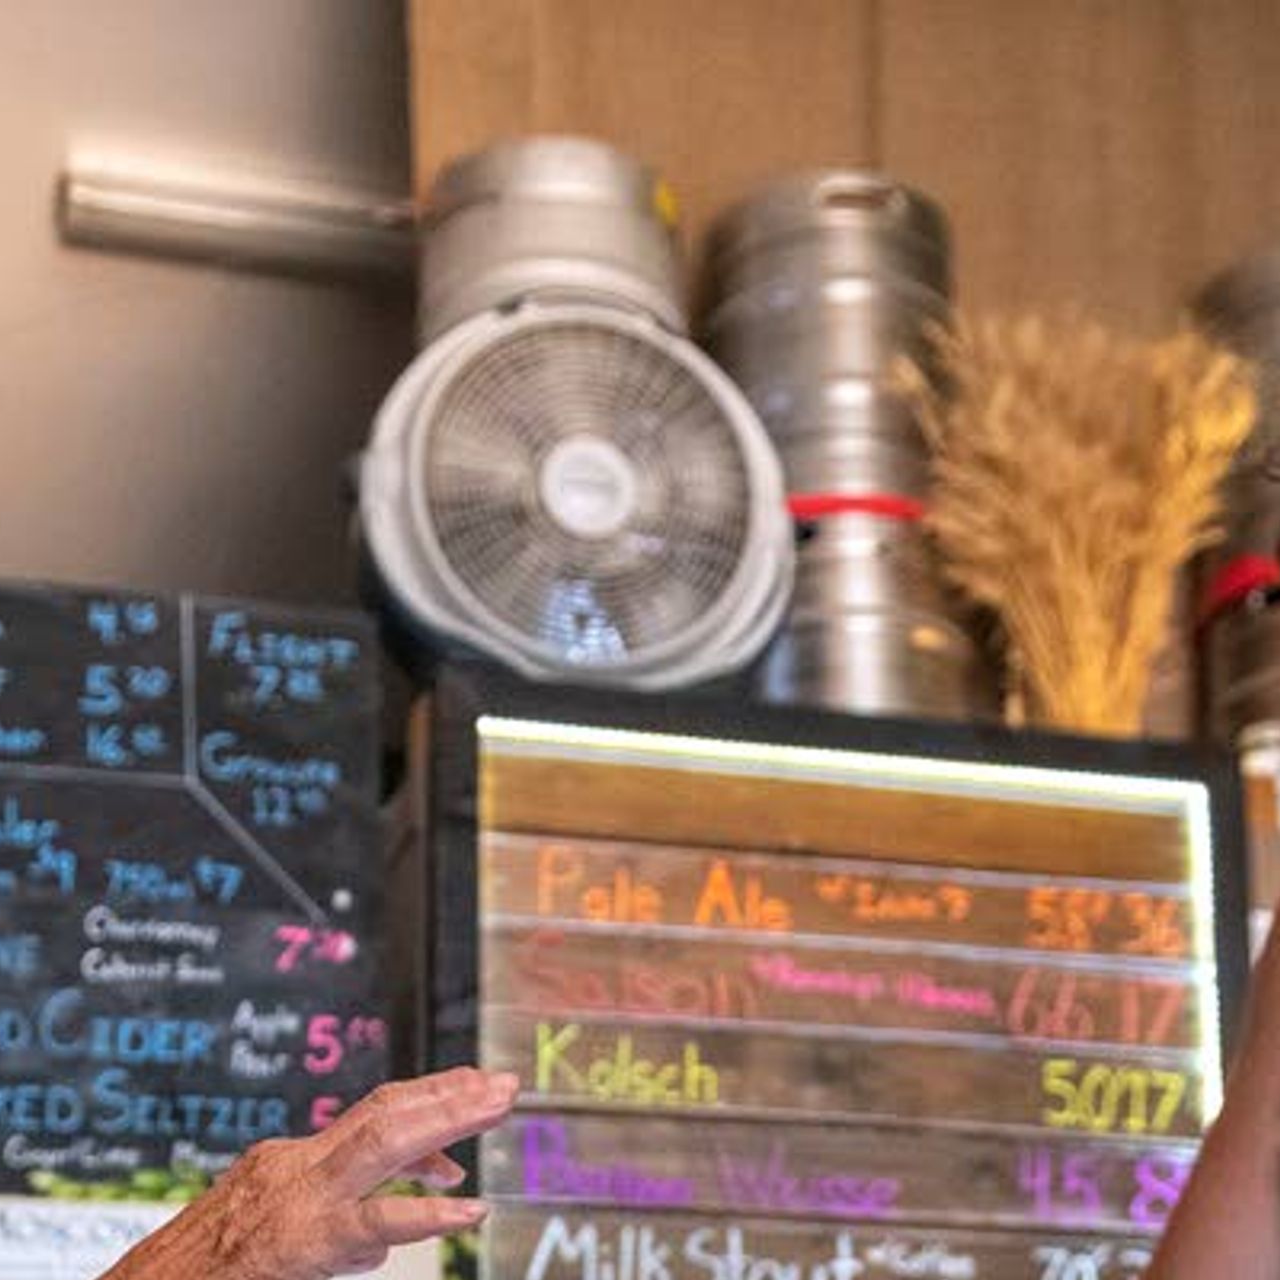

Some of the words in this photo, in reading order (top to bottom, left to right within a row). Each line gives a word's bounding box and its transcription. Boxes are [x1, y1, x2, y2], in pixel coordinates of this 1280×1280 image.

[535, 845, 663, 923] Pale
[693, 857, 794, 936] Ale
[40, 988, 214, 1063] CIDER
